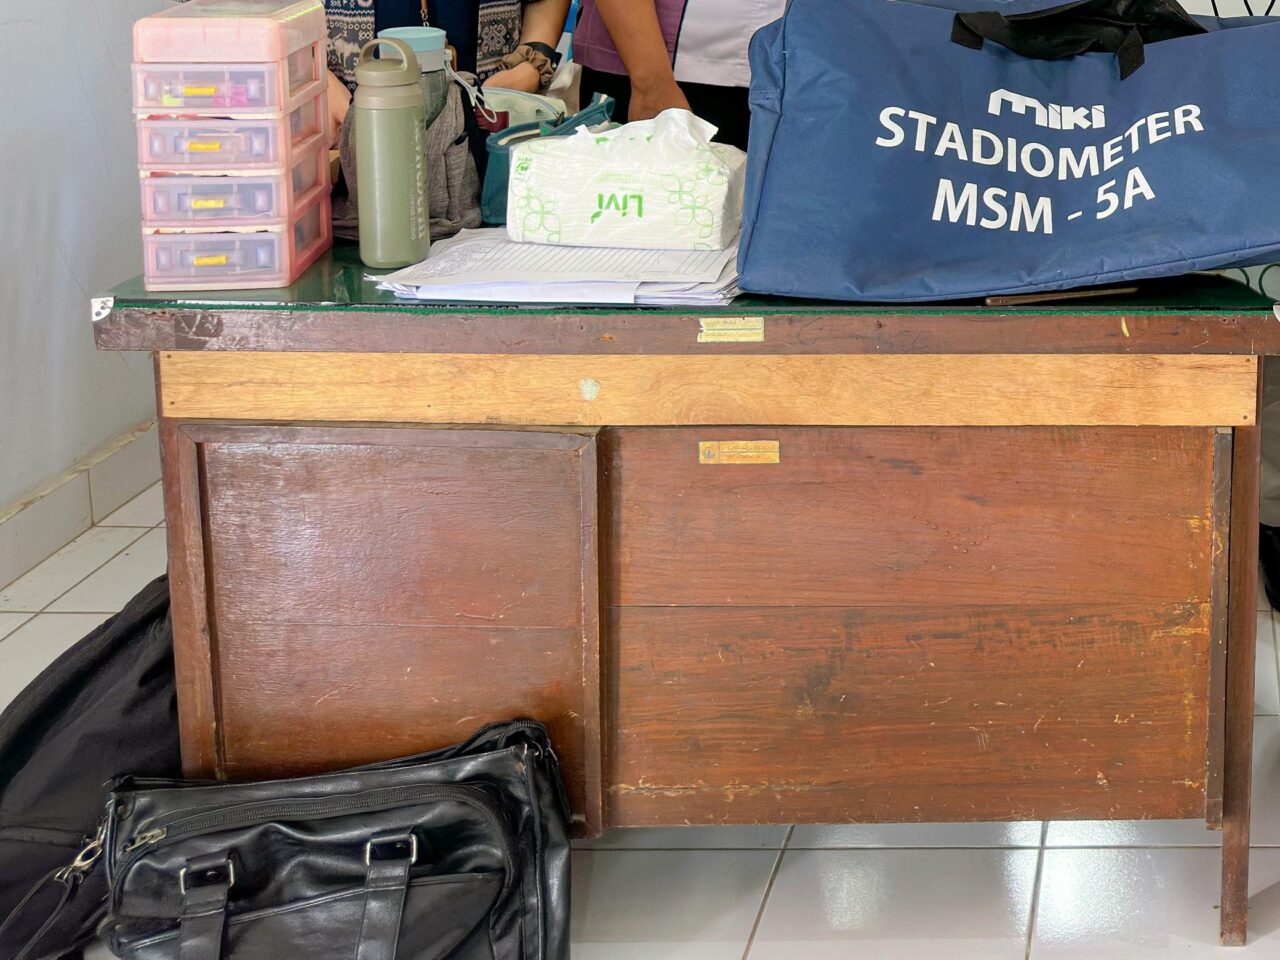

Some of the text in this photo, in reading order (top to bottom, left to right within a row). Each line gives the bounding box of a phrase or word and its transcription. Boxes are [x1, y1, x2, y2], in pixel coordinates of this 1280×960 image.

[988, 88, 1106, 131] miki
[875, 103, 1205, 182] STADIOMETER
[591, 192, 644, 224] Livi
[931, 178, 1054, 235] MSM
[1095, 166, 1157, 221] 5A
